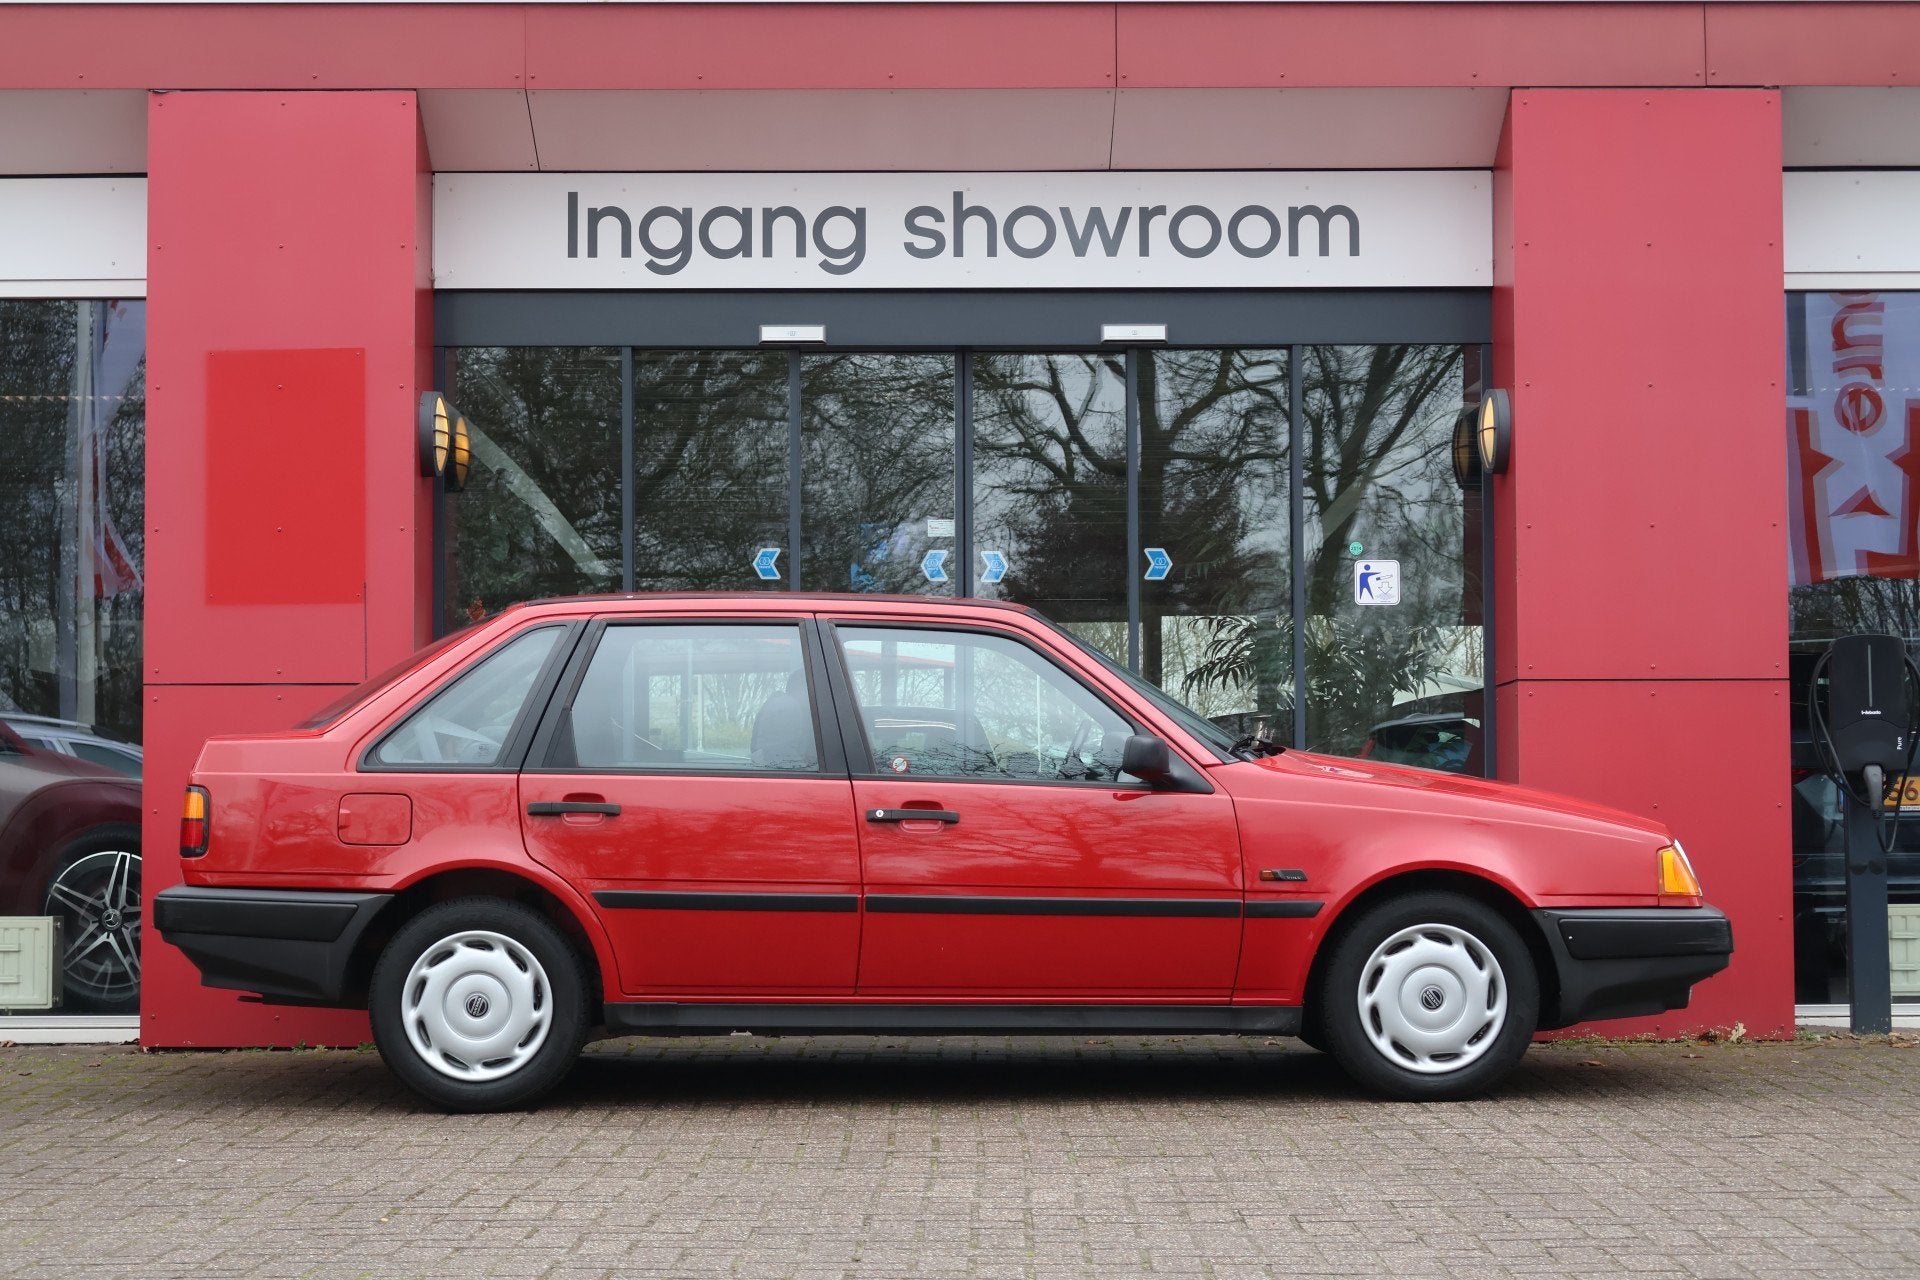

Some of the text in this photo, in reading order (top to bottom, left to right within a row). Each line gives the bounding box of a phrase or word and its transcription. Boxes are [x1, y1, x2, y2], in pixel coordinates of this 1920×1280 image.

[567, 190, 1360, 276] Ingang showroom
[1829, 291, 1886, 438] ure
